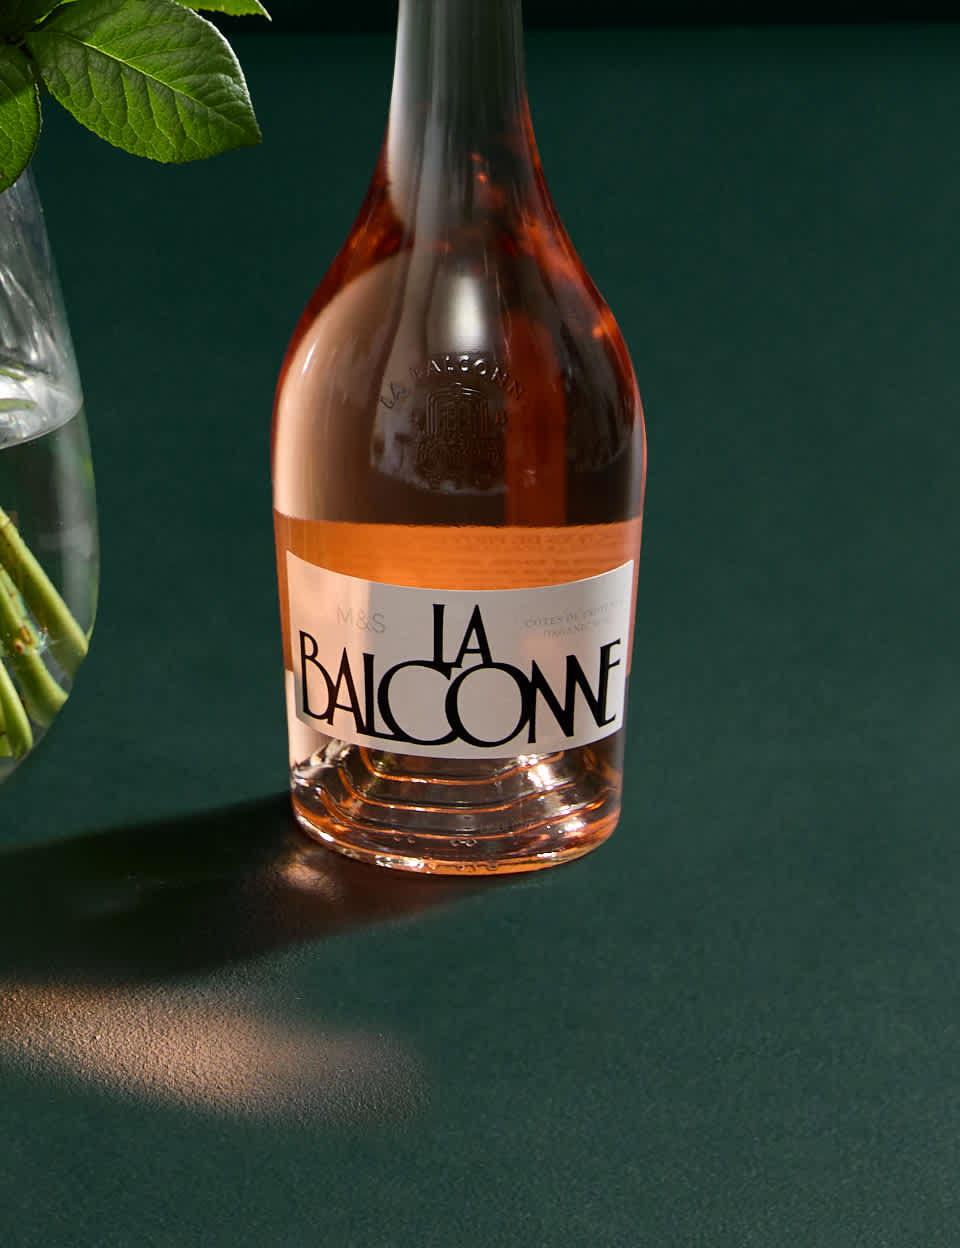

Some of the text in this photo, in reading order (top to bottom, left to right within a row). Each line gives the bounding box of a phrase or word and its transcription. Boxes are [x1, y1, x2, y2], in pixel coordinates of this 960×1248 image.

[335, 604, 387, 633] M&S
[432, 603, 494, 668] LA
[298, 630, 622, 748] BALCONNE
